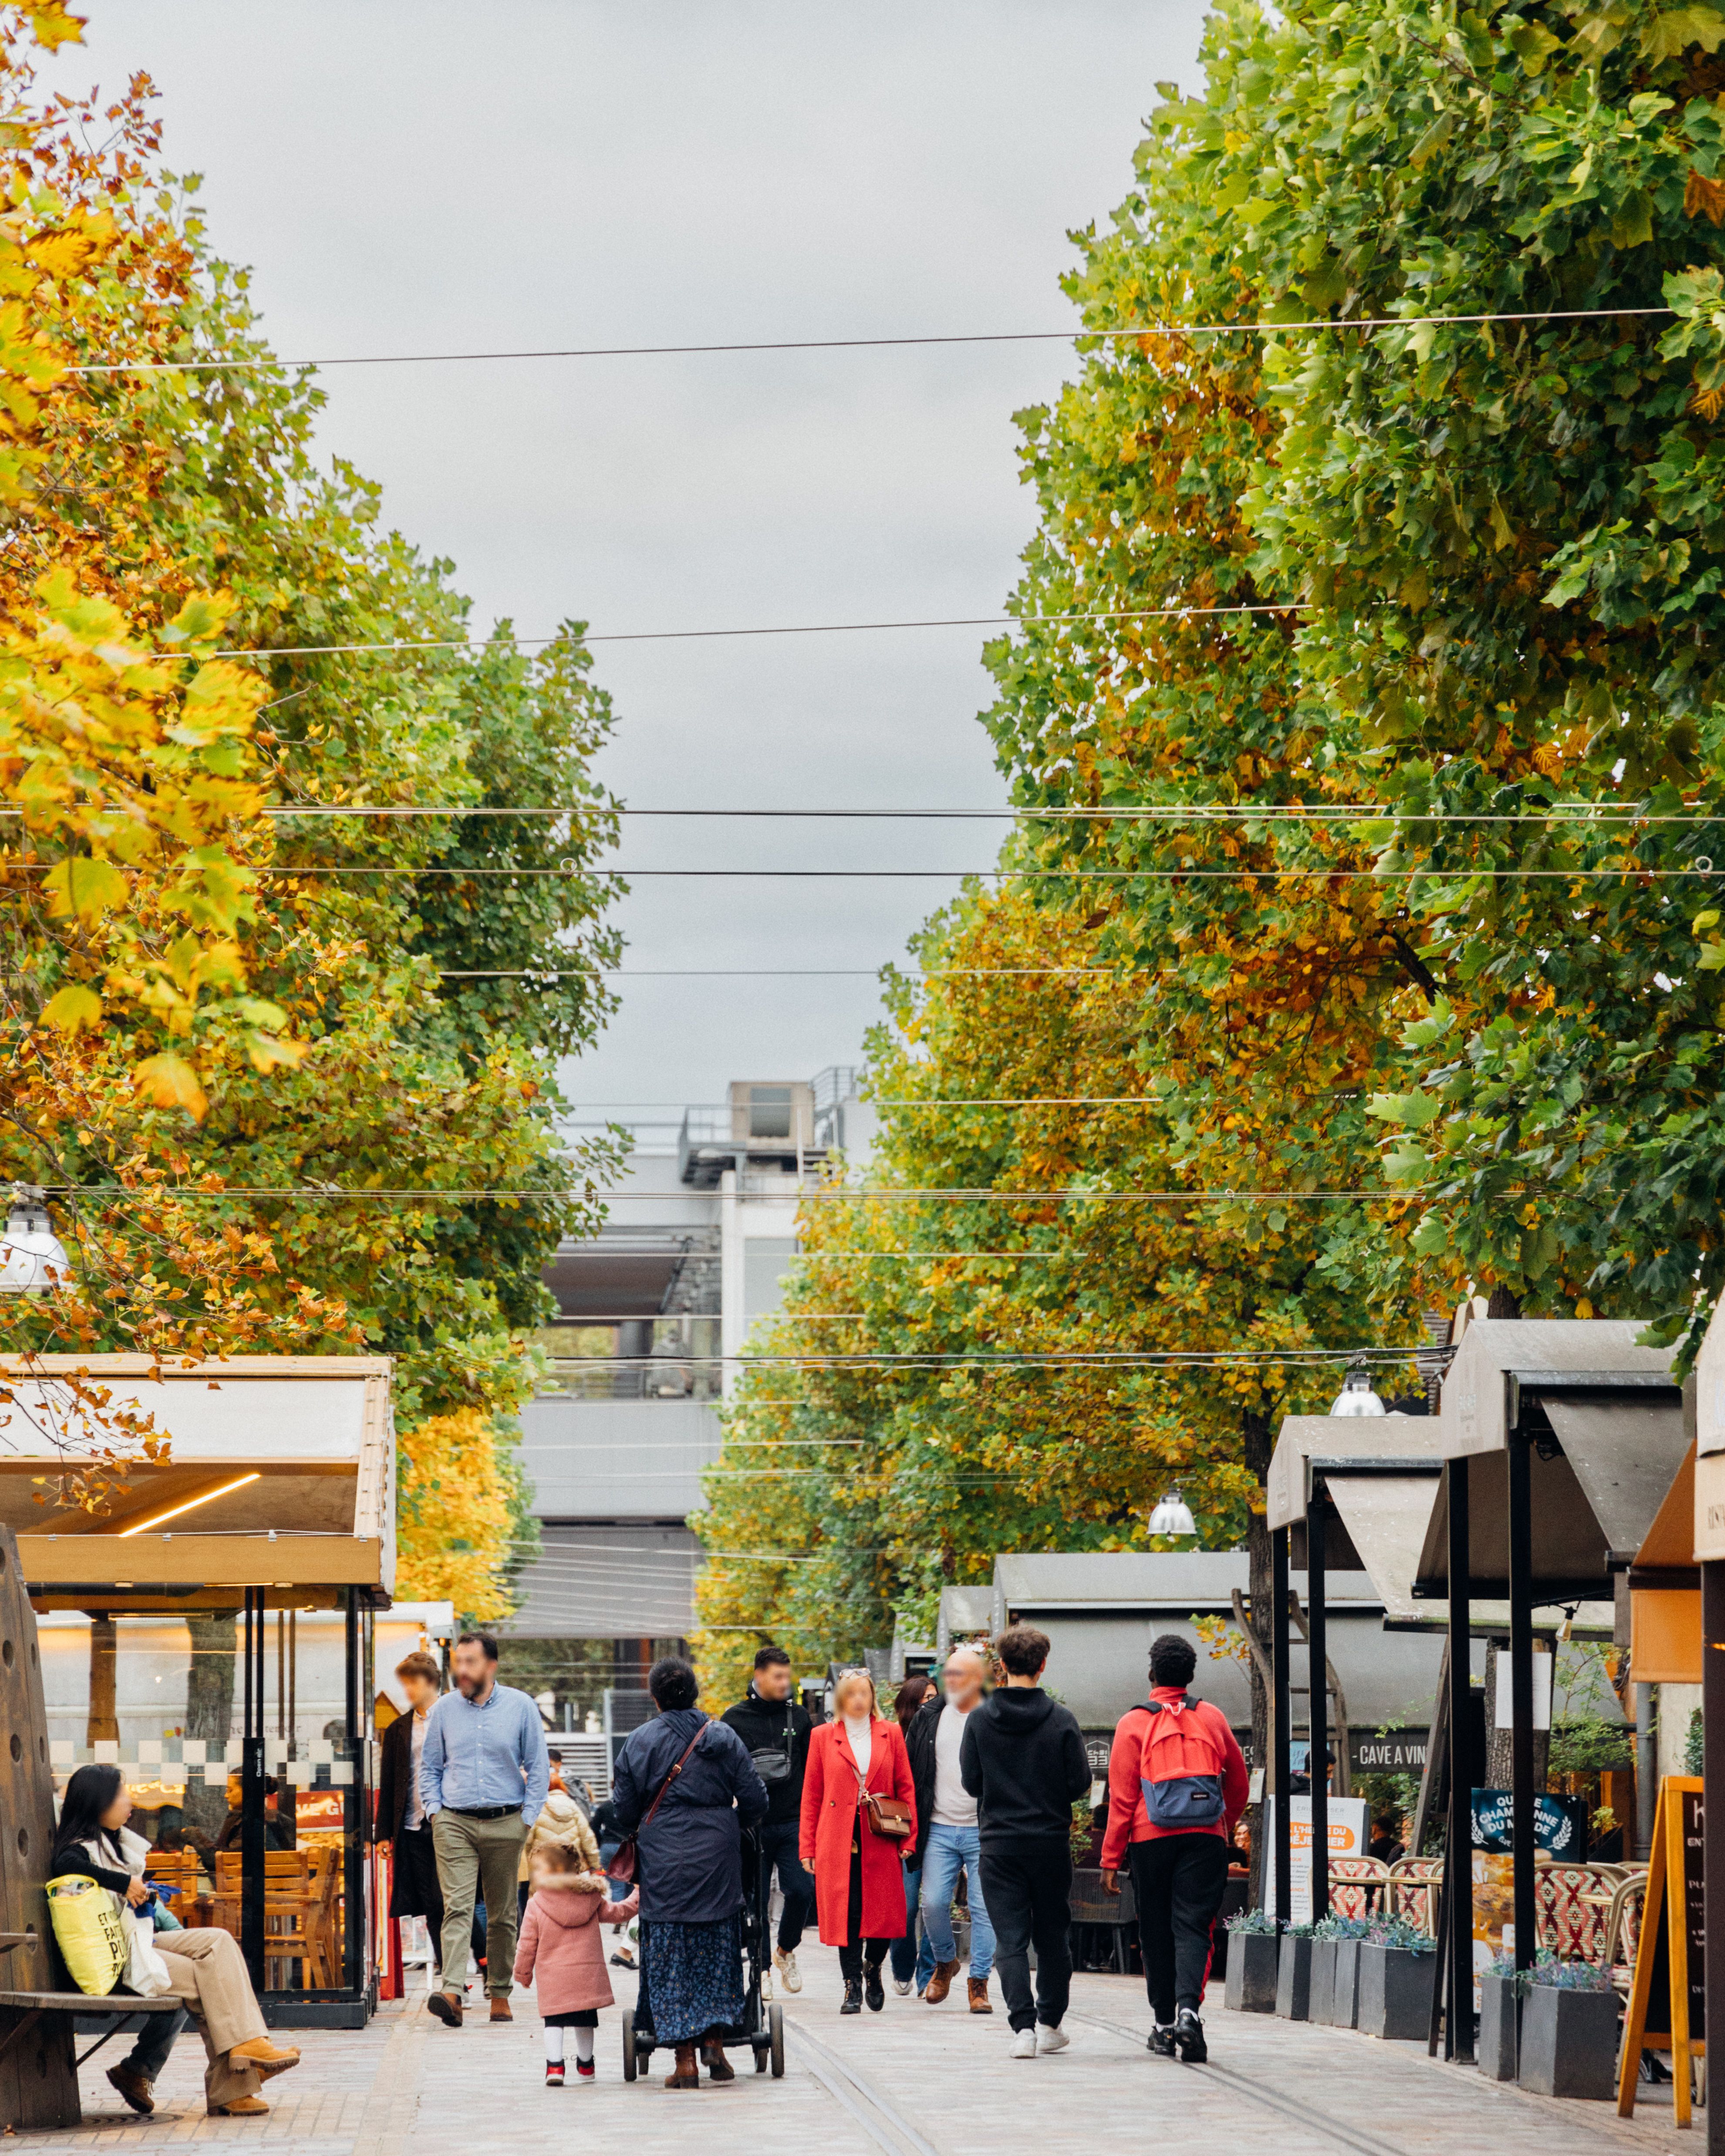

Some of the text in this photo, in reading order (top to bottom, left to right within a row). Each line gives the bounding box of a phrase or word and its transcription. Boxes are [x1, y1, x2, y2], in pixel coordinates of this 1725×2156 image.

[1088, 1756, 1108, 1766] 33
[1360, 1746, 1391, 1764] CAVE
[1394, 1746, 1403, 1764] A
[1488, 1820, 1505, 1833] DU
